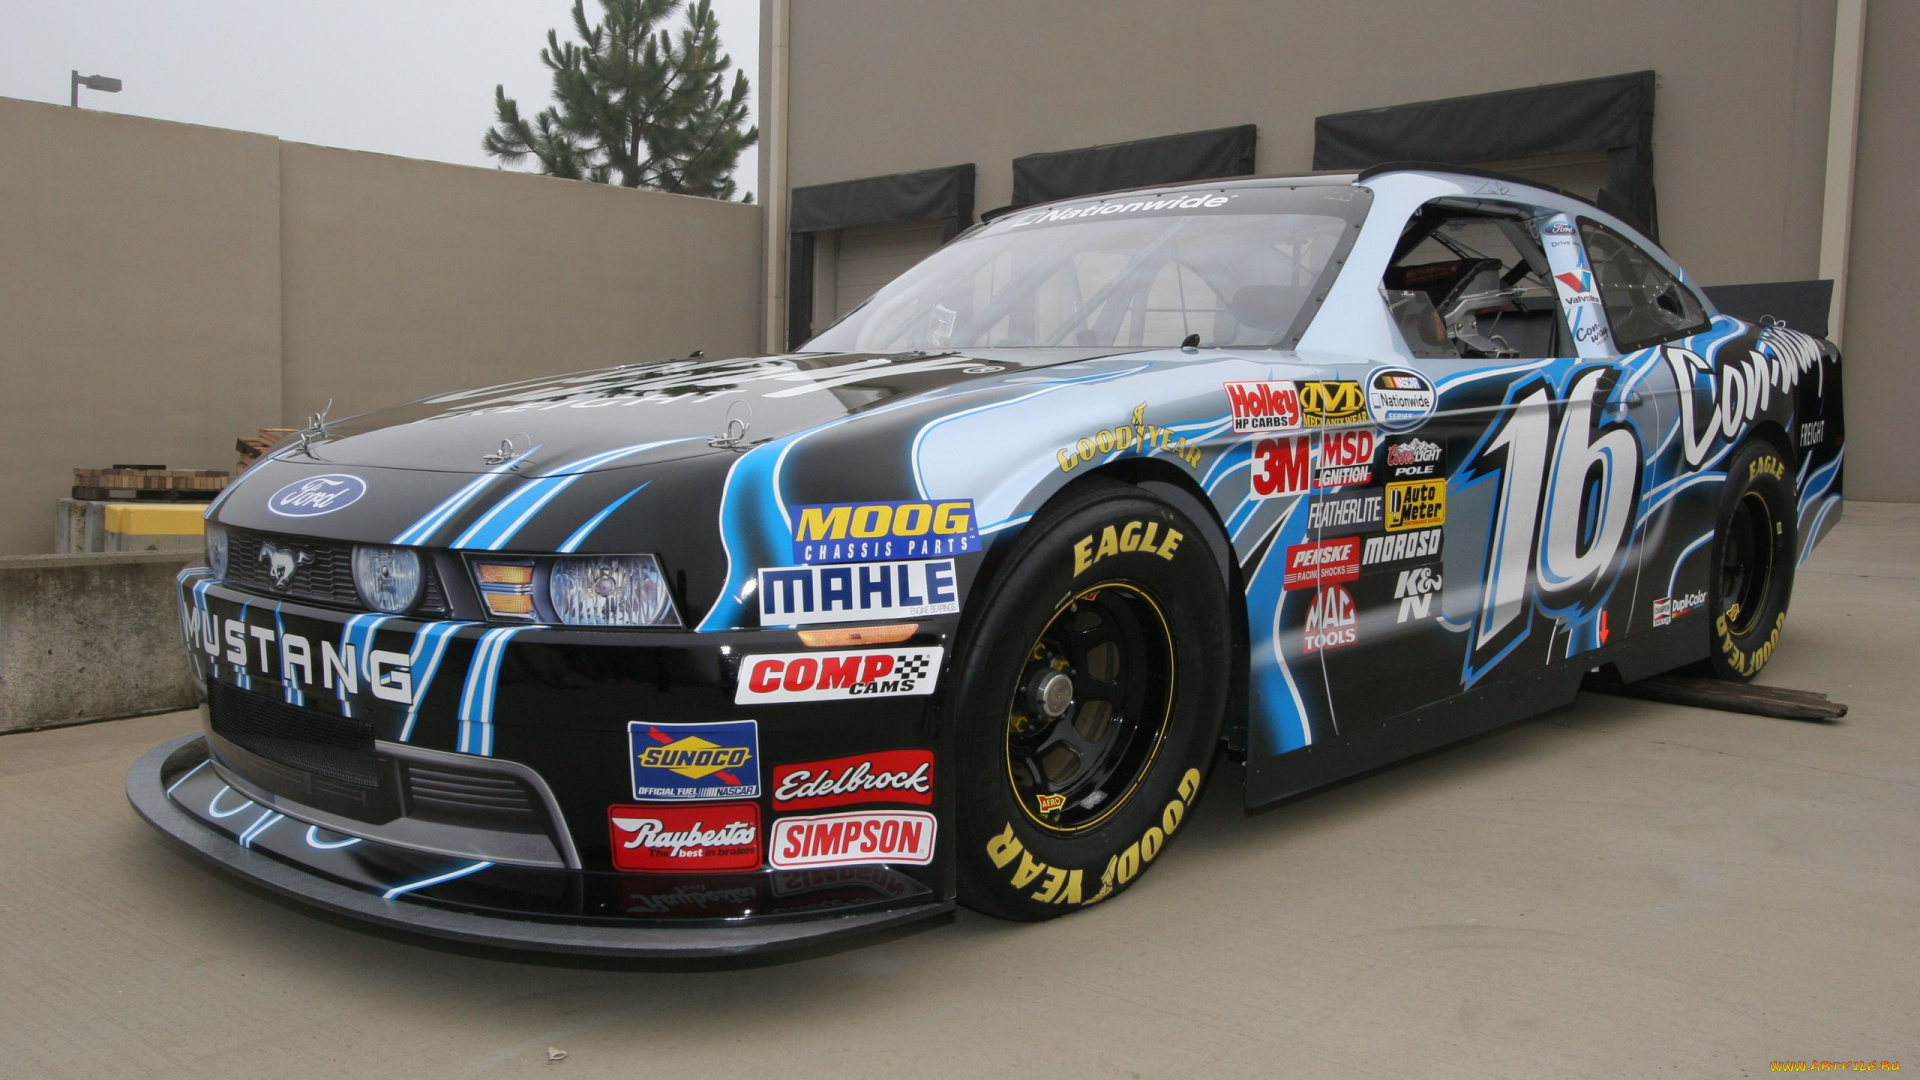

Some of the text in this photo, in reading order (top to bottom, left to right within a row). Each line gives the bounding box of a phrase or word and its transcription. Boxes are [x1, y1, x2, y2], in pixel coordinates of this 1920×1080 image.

[1035, 194, 1228, 223] Nationwide
[1552, 223, 1574, 234] Ford
[1565, 296, 1601, 305] Valvoline
[1393, 377, 1421, 388] NASCAR
[1227, 382, 1300, 425] Holley
[1381, 393, 1430, 407] Nationwide
[1235, 416, 1288, 429] HP CARBS
[1343, 412, 1368, 425] WEAR
[1800, 420, 1825, 447] FREIGHT
[1322, 430, 1374, 467] MSD
[1415, 449, 1442, 461] LIGHT
[1252, 436, 1309, 496] 3M
[1318, 467, 1369, 486] IGNITION
[1395, 466, 1434, 477] POLE
[1749, 455, 1785, 481] EAGLE
[281, 478, 345, 508] Ford
[1403, 484, 1436, 504] Auto
[795, 502, 971, 542] MOOG
[1308, 496, 1382, 530] FEATHERLITE
[1402, 502, 1442, 521] Meter
[1475, 368, 1637, 652] 16
[804, 536, 968, 561] CHASSIS PARTS
[1073, 521, 1184, 578] EAGLE
[1293, 544, 1353, 568] PENSKE
[1361, 528, 1442, 565] MOROSO
[1297, 565, 1346, 581] RACING SHOCKS
[762, 561, 955, 615] MAHLE
[910, 602, 956, 615] ENGINE BEARINGS
[1305, 587, 1356, 632] MAC
[1397, 593, 1433, 623] N
[1672, 590, 1707, 613] Dupli-Color
[1305, 628, 1356, 650] TOOLS
[183, 601, 413, 703] MUSTANG
[748, 654, 895, 694] COMP
[848, 679, 915, 696] CAMS
[644, 747, 747, 767] SUNOCO
[638, 785, 754, 796] OFFICIAL FUEL NASCAR
[774, 761, 930, 801] Edelbrock
[1042, 797, 1061, 808] AERO
[612, 817, 756, 858] Raybestos
[782, 819, 923, 859] SIMPSON
[649, 847, 754, 858] The best in brakes
